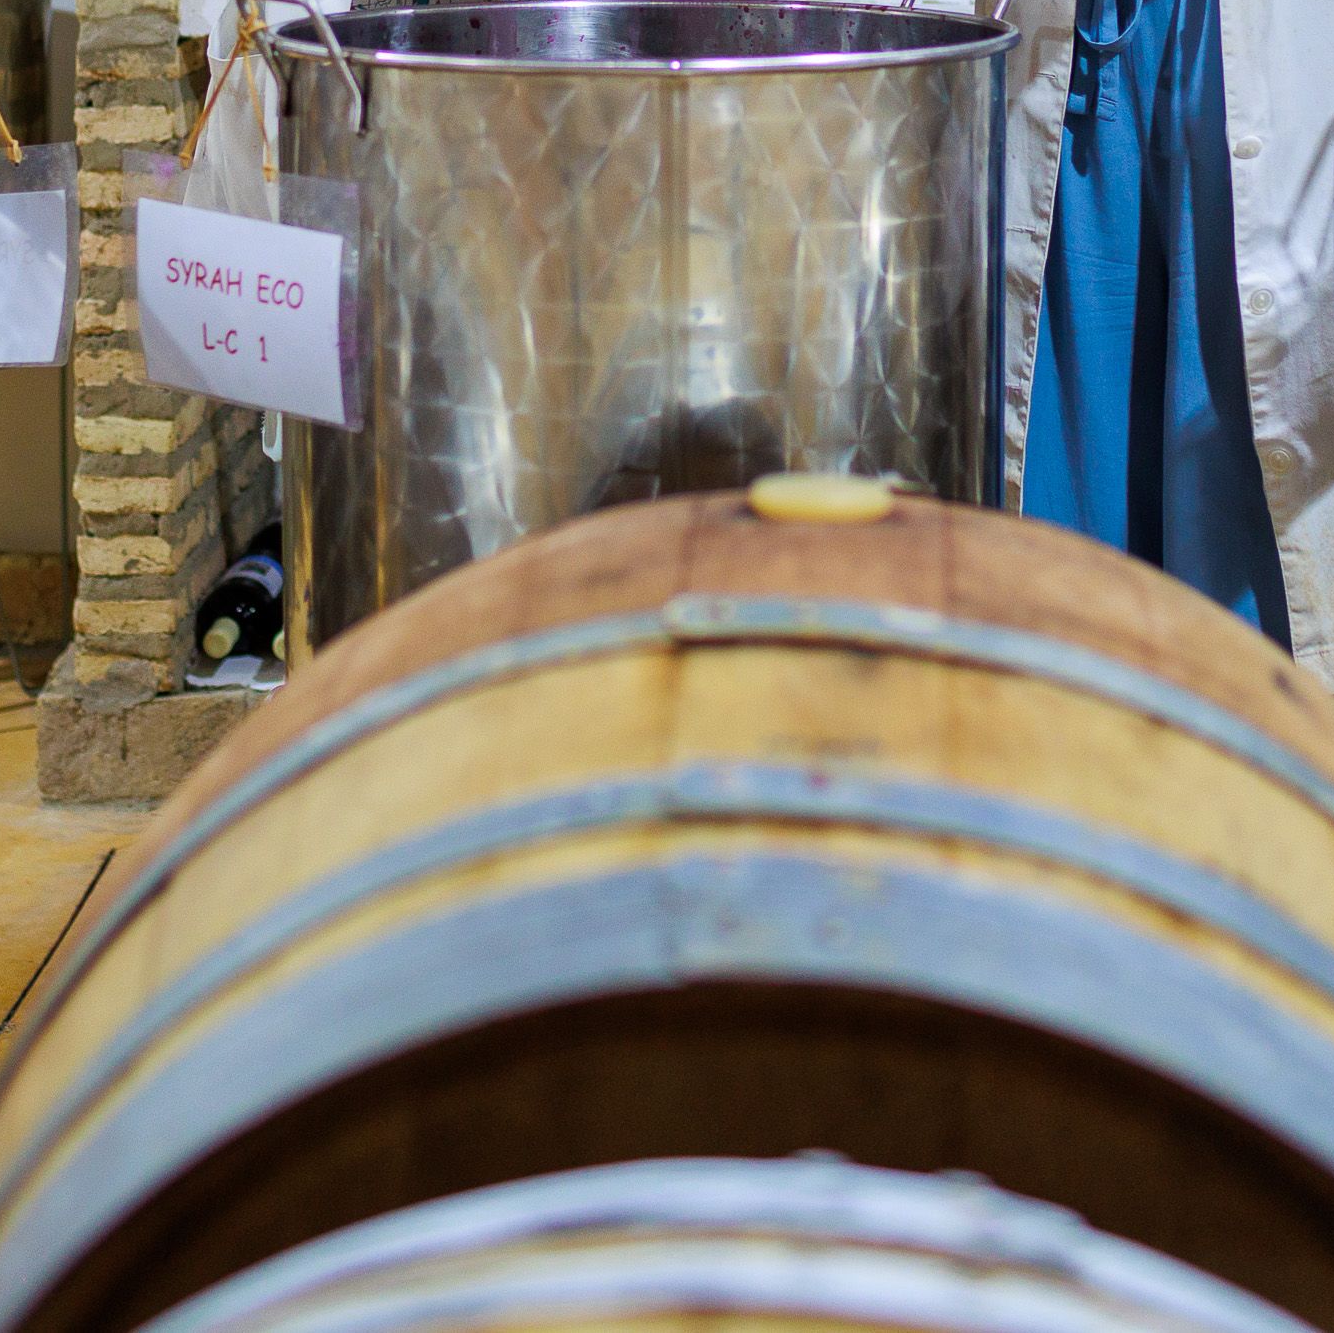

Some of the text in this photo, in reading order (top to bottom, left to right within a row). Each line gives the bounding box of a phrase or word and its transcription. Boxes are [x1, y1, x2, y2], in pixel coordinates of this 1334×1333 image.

[167, 258, 304, 309] SYRAH ECO
[202, 322, 268, 362] L-C 1
